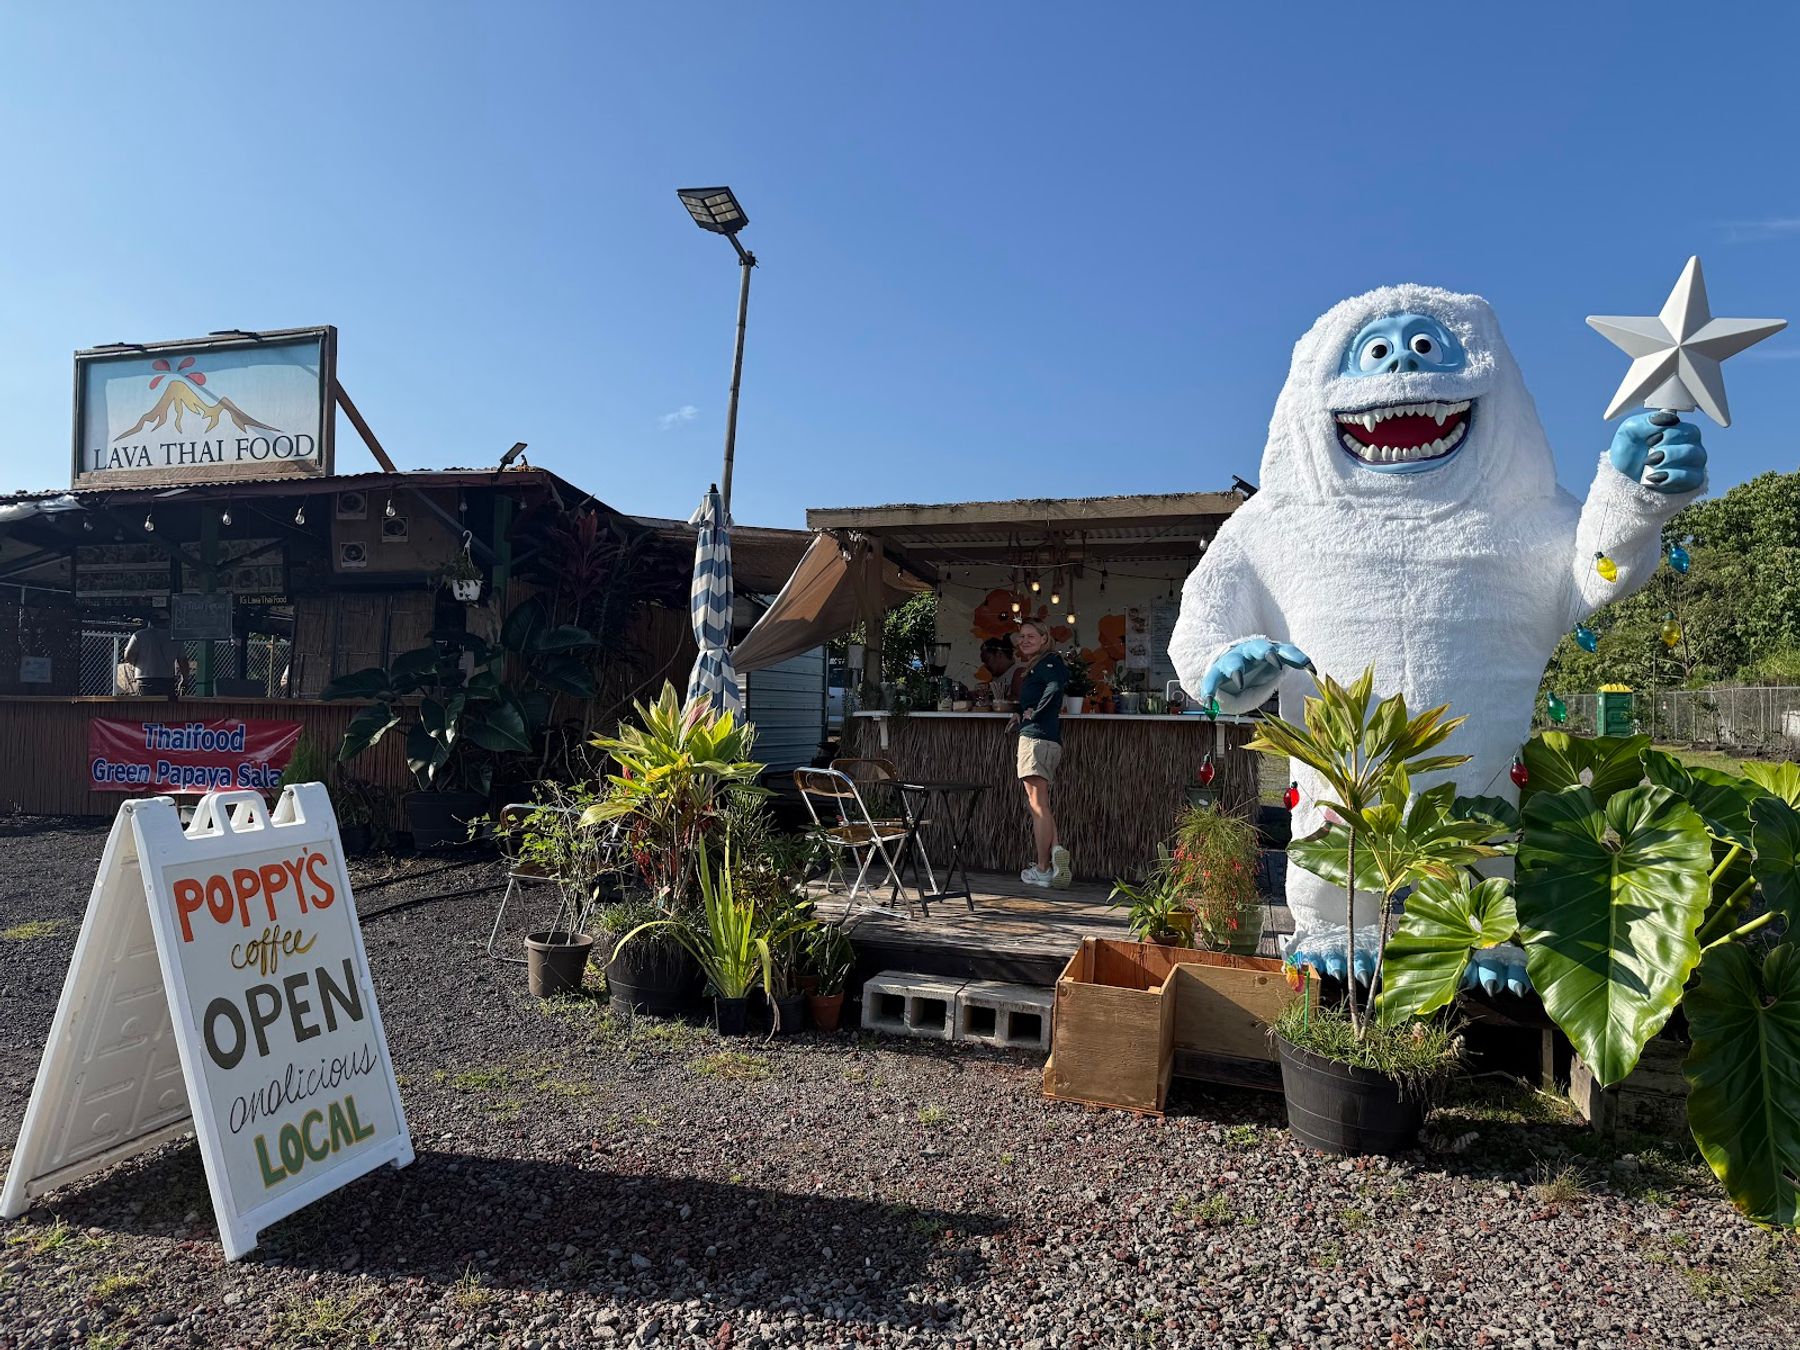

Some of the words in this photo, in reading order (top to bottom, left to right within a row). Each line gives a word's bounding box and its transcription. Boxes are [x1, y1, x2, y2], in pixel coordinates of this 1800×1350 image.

[94, 445, 154, 471] LAVA
[160, 440, 224, 465] THAI
[235, 434, 315, 461] FOOD
[142, 721, 245, 752] Thaifood
[92, 758, 150, 783] Green
[156, 760, 232, 791] Papaya
[237, 763, 283, 789] Sala
[172, 847, 335, 943] POPPY'S
[231, 924, 318, 976] coffee
[203, 957, 365, 1070] OPEN
[254, 1094, 375, 1189] LOCAL
